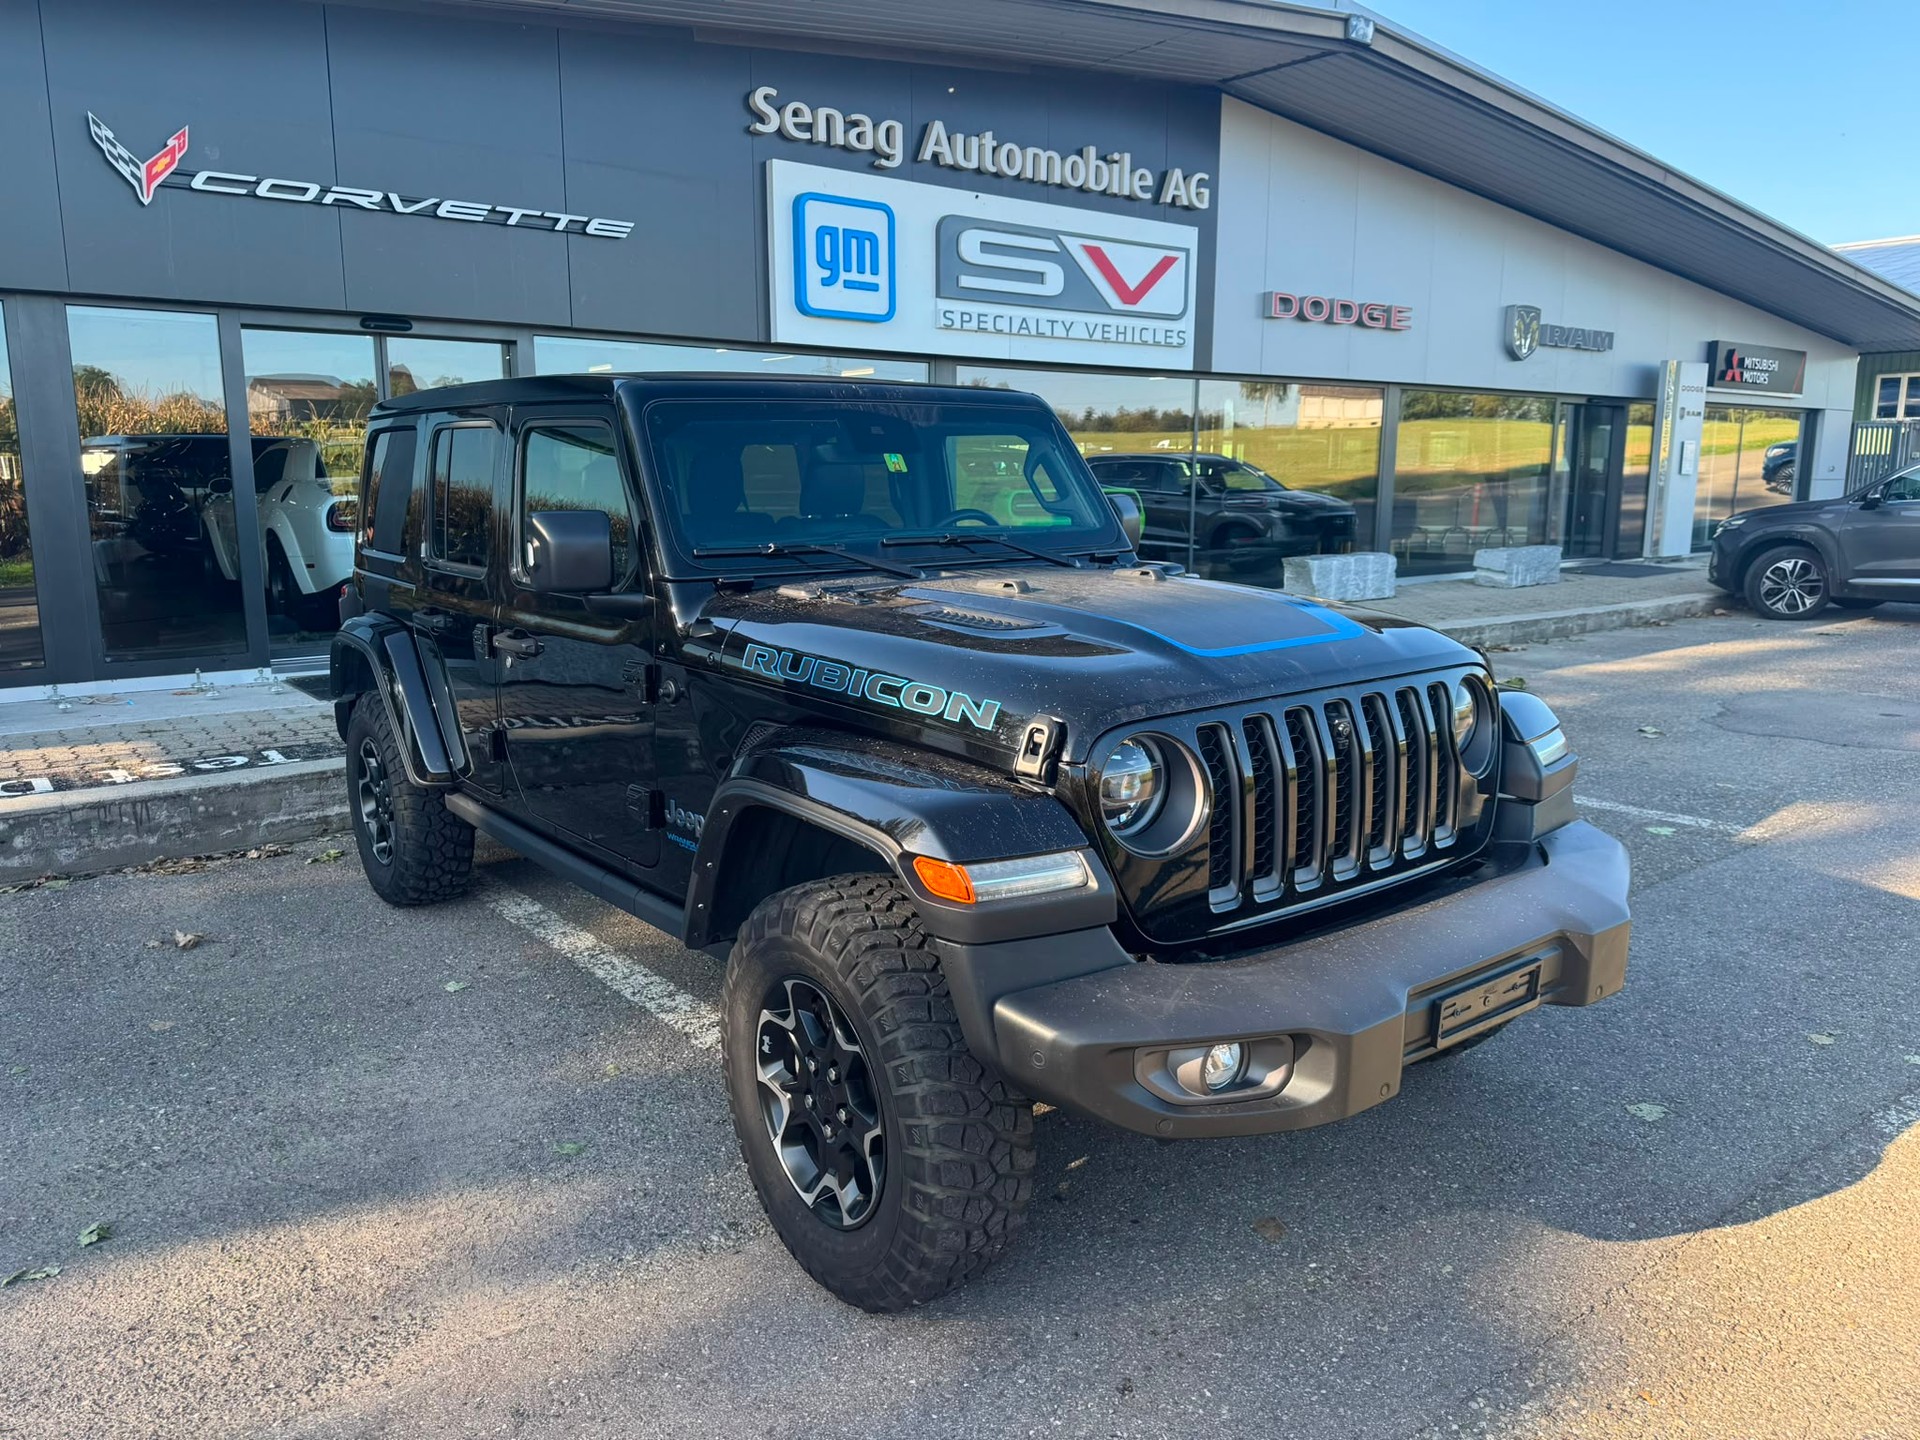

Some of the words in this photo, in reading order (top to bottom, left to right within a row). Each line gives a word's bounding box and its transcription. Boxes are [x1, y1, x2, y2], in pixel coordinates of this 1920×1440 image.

[747, 86, 904, 169] Senag
[917, 120, 1153, 200] Automobile
[1159, 167, 1210, 210] AG
[190, 170, 635, 239] CORVETTE
[816, 225, 880, 288] gm
[957, 228, 1180, 307] SV
[942, 310, 1074, 338] SPECIALTY
[1084, 322, 1187, 347] VEHICLES
[1266, 291, 1413, 331] DODGE
[1543, 323, 1614, 352] RAM
[1742, 370, 1769, 385] MOTORS
[1743, 357, 1779, 372] MITSUBISHI
[741, 643, 1001, 732] RUBICON
[665, 799, 705, 838] Jeep
